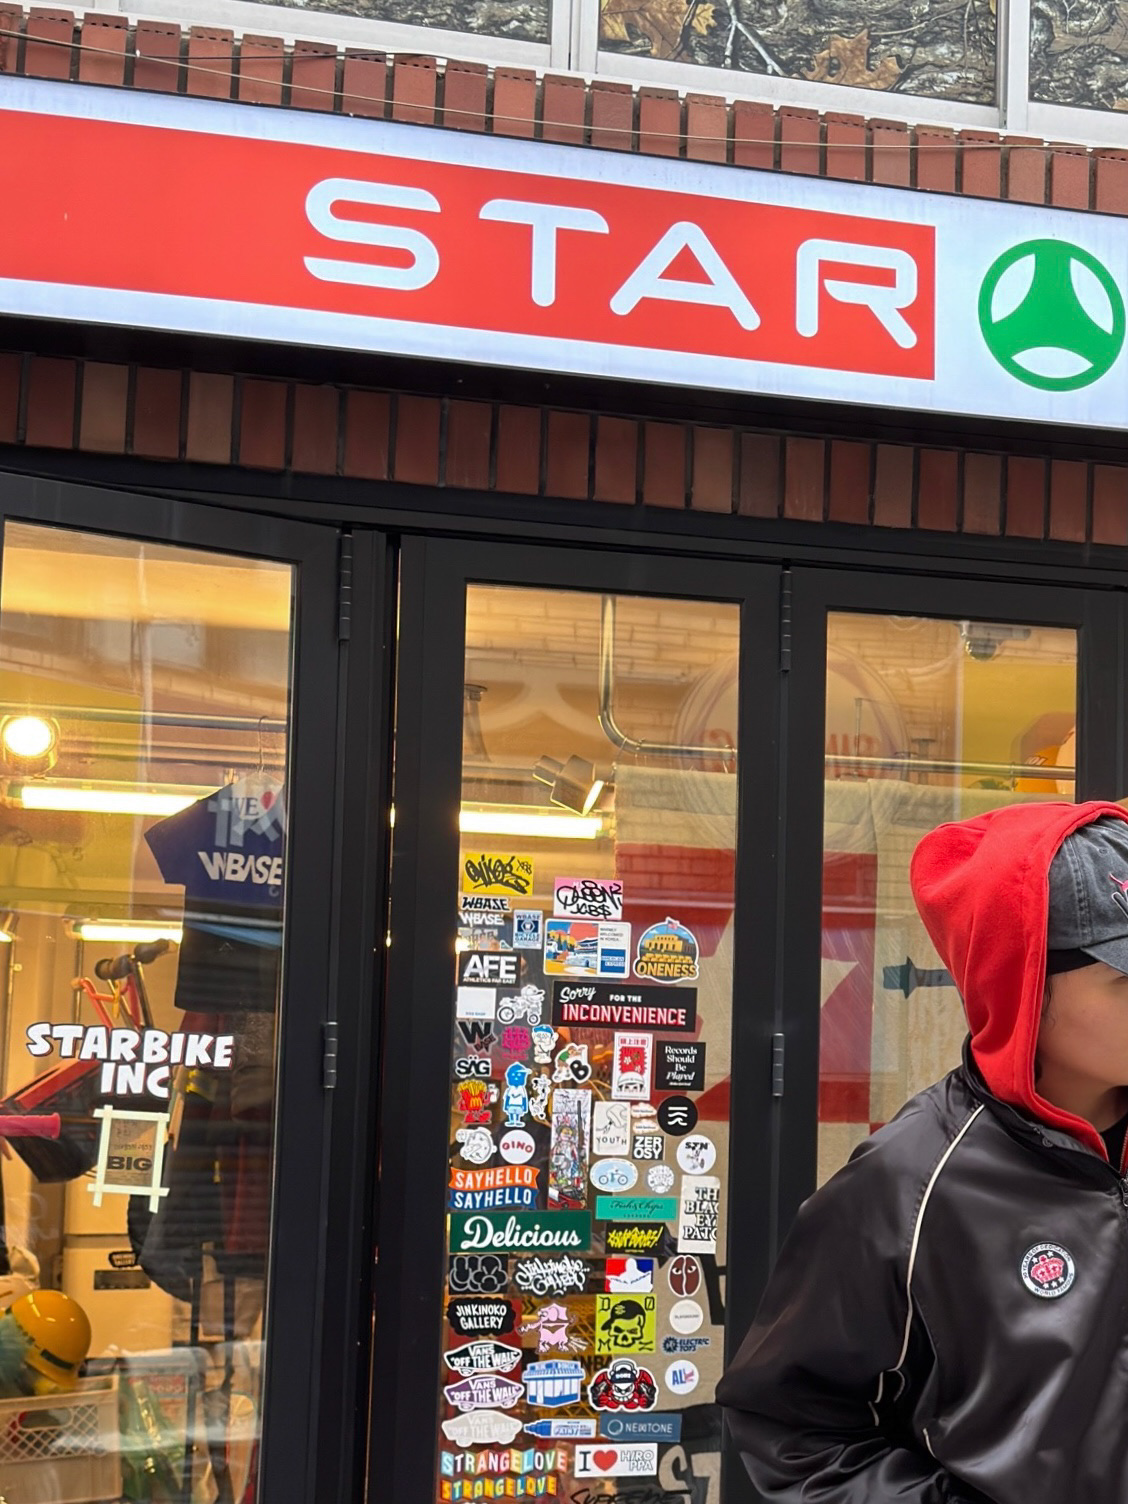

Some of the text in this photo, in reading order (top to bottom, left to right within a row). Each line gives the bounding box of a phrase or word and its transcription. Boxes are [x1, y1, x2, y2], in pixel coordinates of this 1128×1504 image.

[303, 177, 918, 350] STAR
[198, 851, 282, 885] WBASE
[463, 954, 517, 979] AFE
[637, 962, 696, 977] ONENESS
[558, 985, 642, 1004] Sorry FOR THE
[562, 1003, 687, 1026] INCONVENIENCE
[26, 1022, 235, 1069] STARBIKE
[665, 1046, 697, 1055] Records
[667, 1055, 695, 1063] Should
[100, 1062, 173, 1099] INC
[666, 1072, 695, 1082] Played
[596, 1137, 627, 1145] YOUTH
[635, 1137, 662, 1147] ZER
[634, 1147, 661, 1159] OSY
[107, 1156, 152, 1171] BIG
[455, 1167, 532, 1189] SAYHELLO
[454, 1189, 532, 1209] SAYHELLO
[695, 1187, 719, 1201] TH
[696, 1214, 718, 1226] EY
[461, 1216, 582, 1250] Delicious
[456, 1304, 507, 1316] JINKINOKO
[460, 1317, 503, 1330] GALLERY
[468, 1345, 494, 1355] VANS
[469, 1380, 496, 1389] VANS
[440, 1448, 568, 1476] STRANGELOVE
[579, 1449, 654, 1471] I HIRO
[629, 1461, 653, 1471] PPA
[440, 1475, 557, 1500] STRANGELOVE
